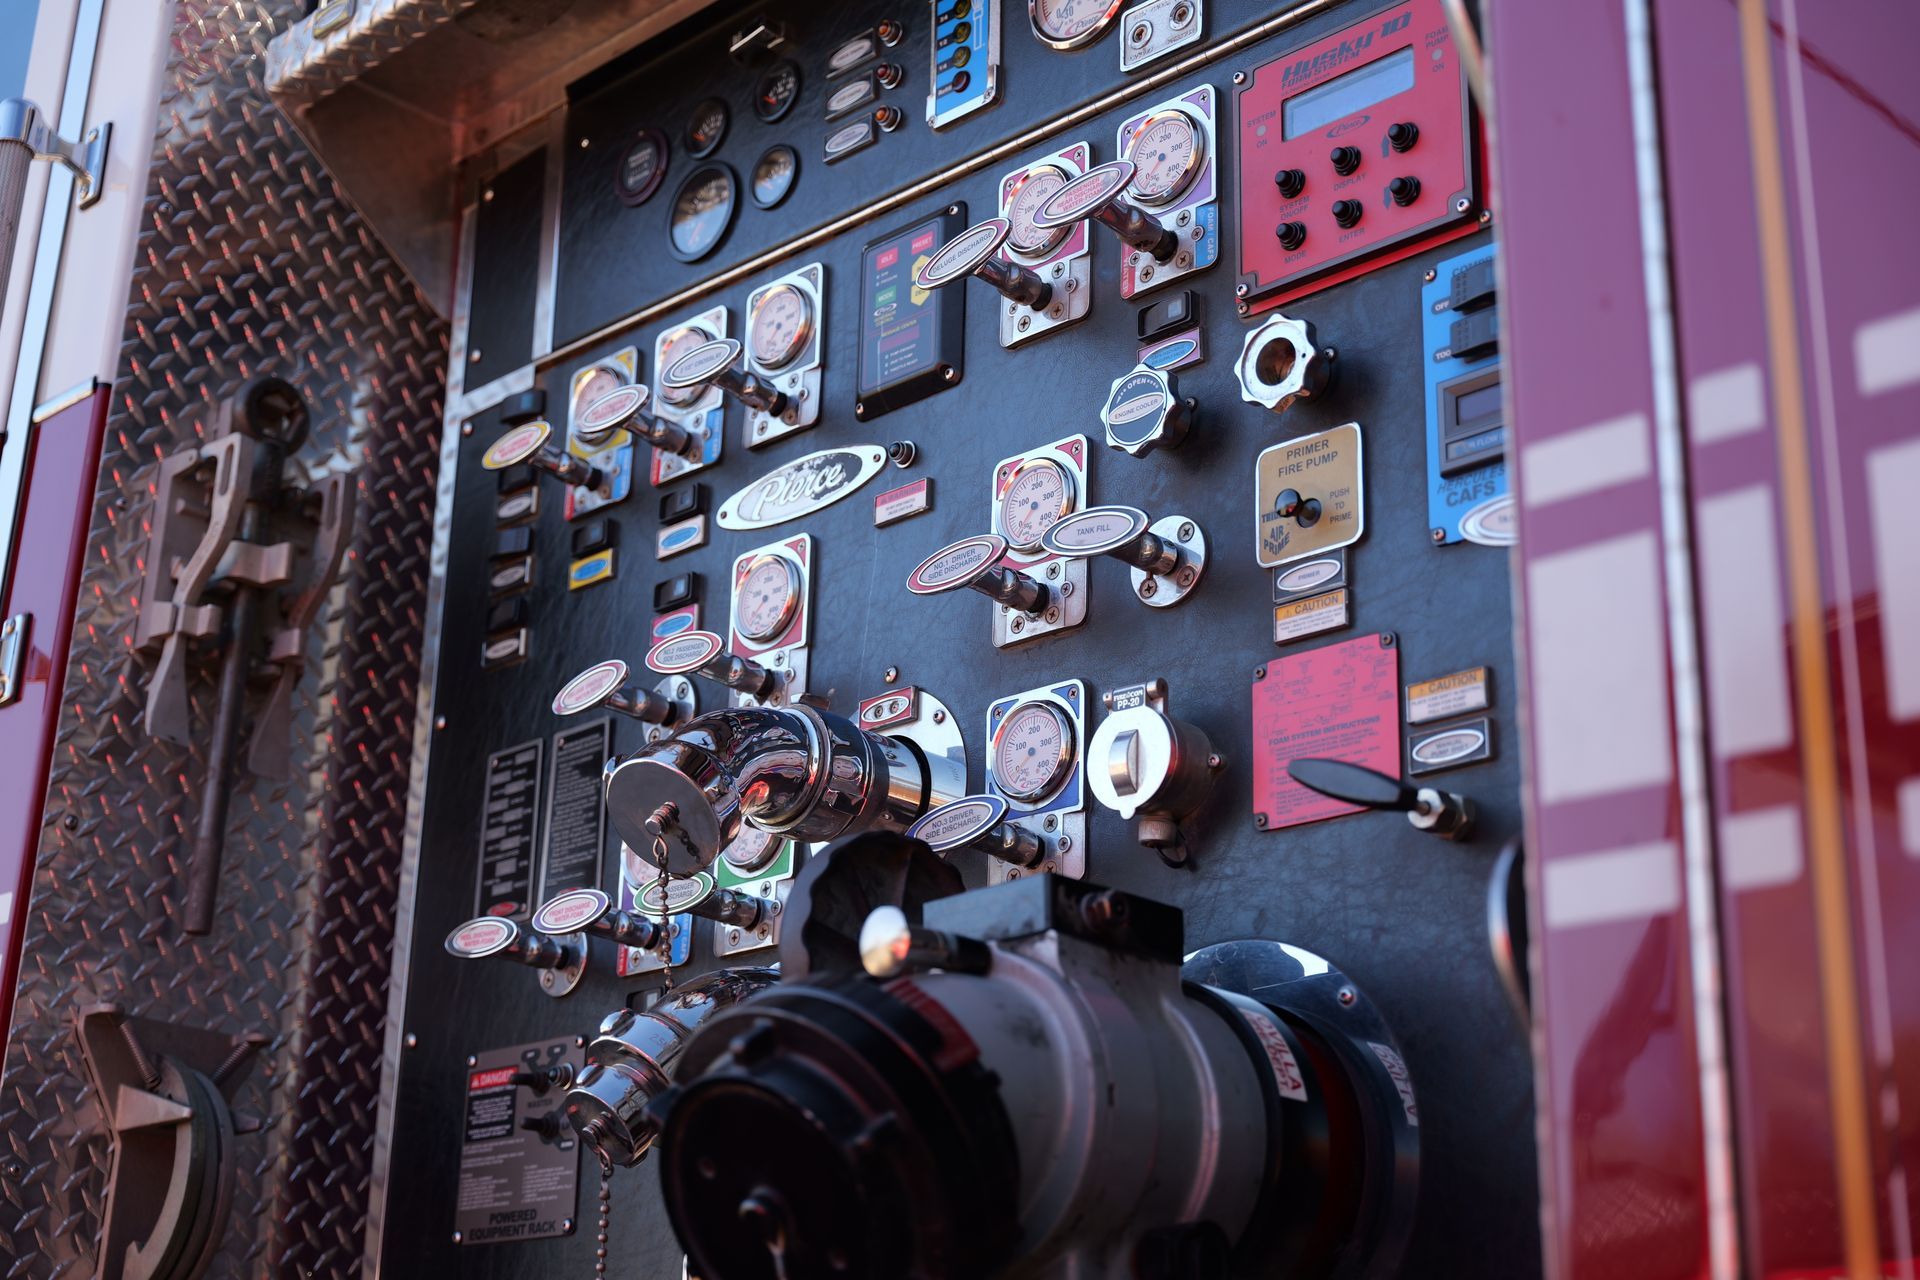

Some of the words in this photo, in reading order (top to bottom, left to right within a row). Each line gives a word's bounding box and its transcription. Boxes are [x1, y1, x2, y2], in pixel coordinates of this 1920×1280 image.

[1424, 26, 1449, 40] FOAM
[1281, 31, 1375, 83] Husky
[1380, 11, 1412, 39] 10
[1425, 34, 1450, 49] PUMP
[1281, 71, 1313, 90] FOAM
[1314, 50, 1360, 75] SYSTEM
[1432, 62, 1445, 73] ON
[1247, 110, 1277, 128] SYSTEM
[1159, 133, 1172, 143] 200
[1256, 139, 1268, 149] ON
[1170, 142, 1183, 153] 300
[1145, 150, 1157, 160] 100
[1167, 163, 1180, 172] 400
[1065, 176, 1100, 197] PASSENGER
[1333, 173, 1366, 191] DISPLAY
[1036, 187, 1047, 197] 200
[1024, 204, 1035, 214] 100
[1057, 197, 1073, 209] REAR
[1279, 196, 1310, 213] SYSTEM
[1280, 204, 1309, 221] ON/OFF
[1338, 227, 1365, 243] ENTER
[932, 253, 957, 273] DELUGE
[957, 232, 992, 257] DISCHARGE
[1206, 237, 1214, 260] CAFS
[1284, 252, 1306, 264] MODE
[1435, 300, 1450, 311] OFF
[1127, 378, 1147, 390] OPEN
[1114, 407, 1135, 420] ENGINE
[1136, 399, 1158, 412] COOLER
[1286, 438, 1329, 460] PRIMER
[1278, 461, 1303, 478] FIRE
[1306, 451, 1338, 470] PUMP
[753, 464, 846, 520] Pierce
[1031, 480, 1043, 490] 200
[1042, 490, 1055, 501] 300
[1329, 487, 1350, 500] PUSH
[1446, 480, 1495, 507] CAFS
[1018, 497, 1030, 507] 100
[1335, 501, 1345, 510] TO
[1040, 511, 1052, 521] 400
[1329, 511, 1352, 525] PRIME
[1076, 526, 1094, 536] TANK
[1095, 523, 1111, 533] FILL
[1270, 524, 1284, 542] AIR
[1263, 532, 1290, 555] PRIME
[928, 568, 943, 580] SIDE
[943, 553, 983, 575] DISCHARGE
[934, 558, 949, 571] NO.1
[951, 548, 976, 562] DRIVER
[1297, 569, 1321, 581] PRIMER
[1294, 594, 1339, 616] CAUTION
[1428, 675, 1477, 693] CAUTION
[1117, 697, 1140, 710] PP-20
[1028, 724, 1041, 734] 200
[1268, 736, 1290, 746] FOAM
[1291, 728, 1322, 742] SYSTEM
[1323, 715, 1380, 734] INSTRUCTIONS
[1015, 741, 1027, 751] 100
[1040, 737, 1052, 748] 300
[1037, 759, 1050, 769] 400
[932, 817, 948, 828] NO.3
[949, 808, 974, 823] DRIVER
[925, 829, 940, 839] SIDE
[941, 815, 982, 835] DISCHARGE
[489, 1209, 537, 1225] POWERED
[470, 1223, 525, 1241] EQUIPMENT
[529, 1219, 556, 1234] RACK
